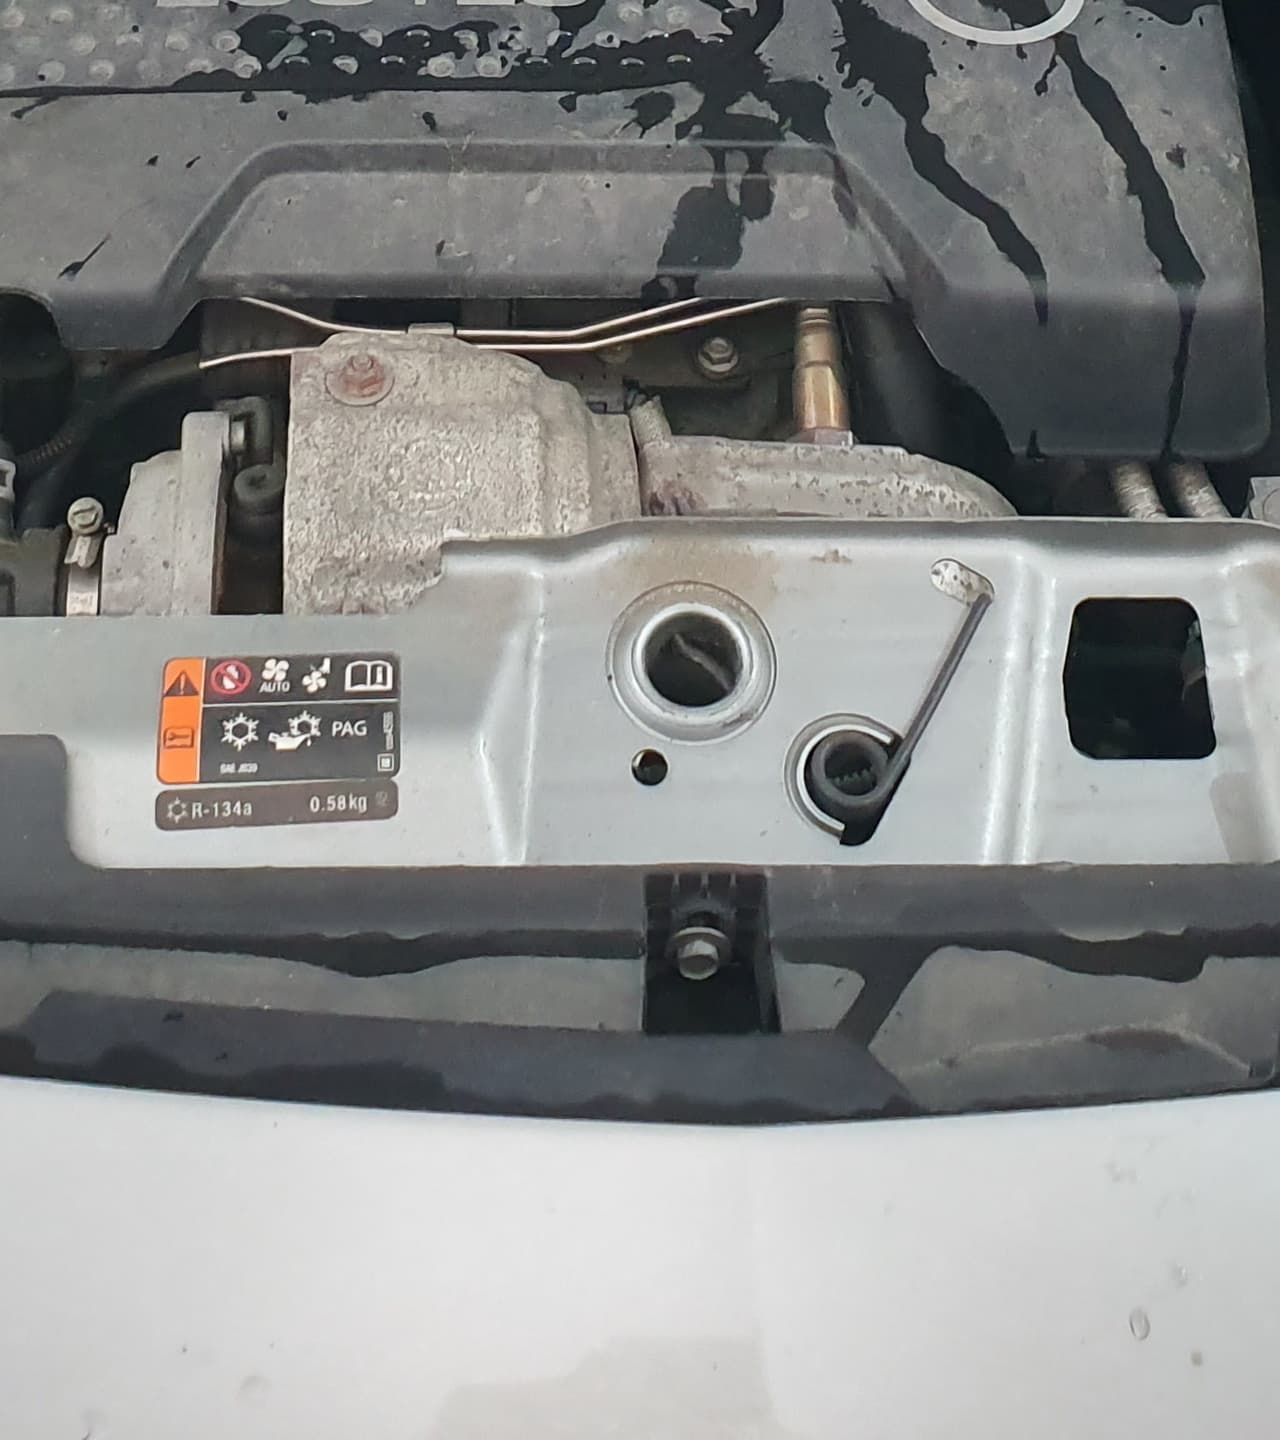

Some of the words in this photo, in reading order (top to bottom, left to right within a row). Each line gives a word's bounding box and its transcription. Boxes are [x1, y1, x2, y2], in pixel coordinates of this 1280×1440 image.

[259, 682, 291, 693] AUTO
[331, 720, 368, 738] PAG
[191, 801, 253, 820] R-134a
